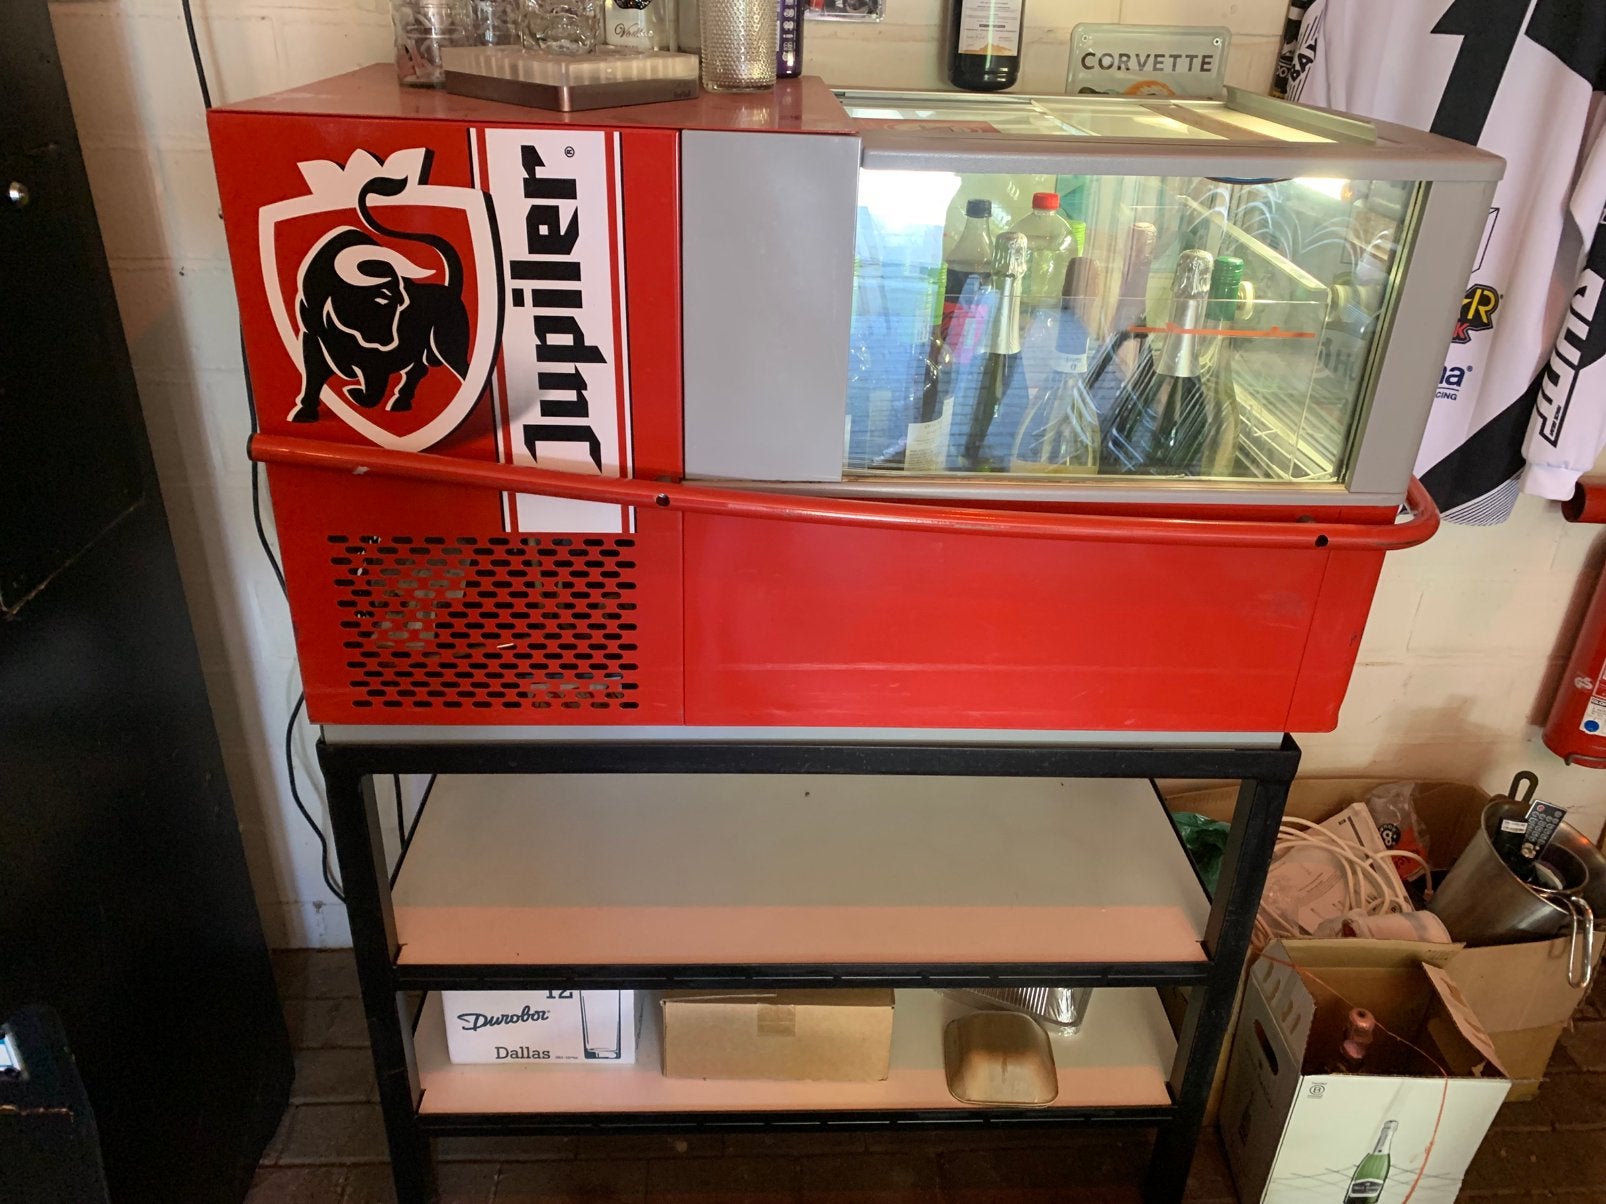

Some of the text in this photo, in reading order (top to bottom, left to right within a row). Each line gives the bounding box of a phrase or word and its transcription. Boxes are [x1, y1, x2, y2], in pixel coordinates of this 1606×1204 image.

[1081, 52, 1214, 73] CORVETTE
[457, 1004, 549, 1032] Durobor
[495, 1046, 551, 1060] Dallas
